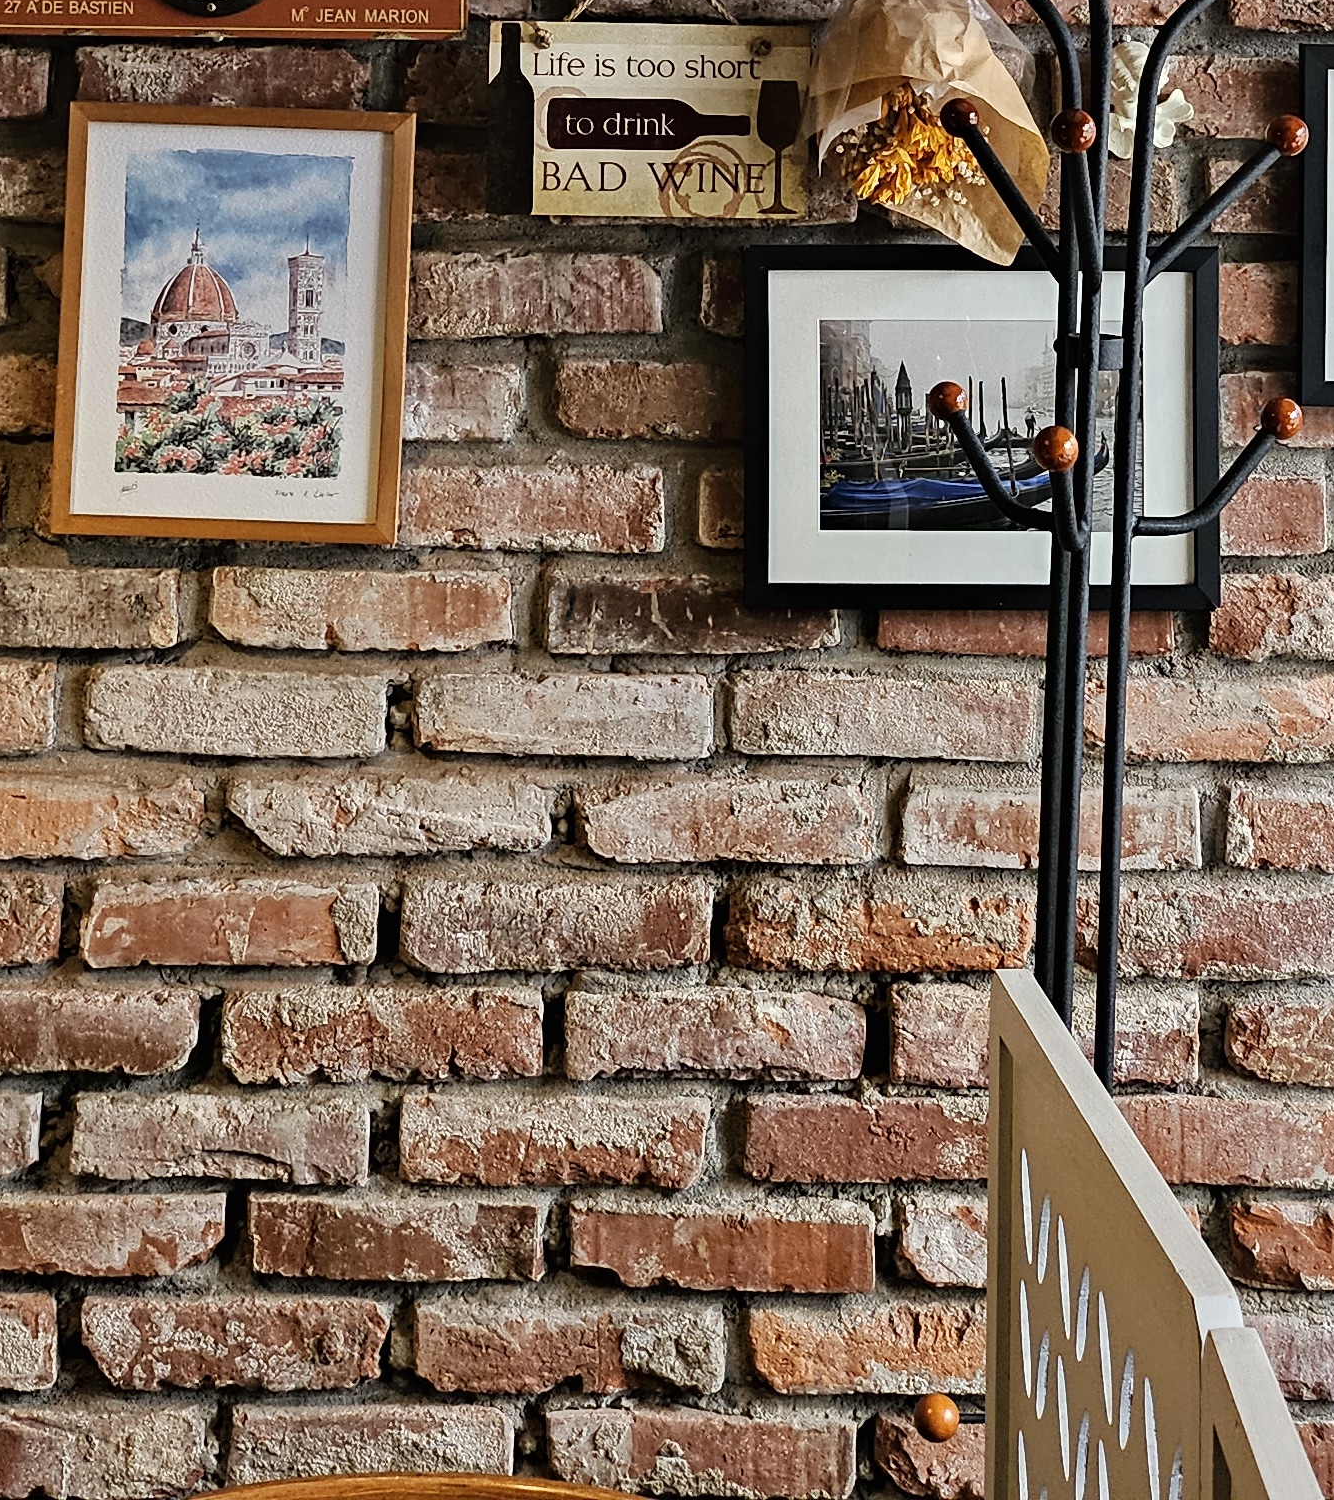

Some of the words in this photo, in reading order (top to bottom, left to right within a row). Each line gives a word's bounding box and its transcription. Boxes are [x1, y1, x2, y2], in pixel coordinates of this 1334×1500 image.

[4, 0, 21, 13] 27
[42, 0, 63, 14] DE
[69, 0, 134, 15] BASTIEN
[316, 8, 356, 23] JEAN
[364, 9, 429, 24] MARION
[532, 51, 585, 77] Life
[594, 53, 616, 78] is
[626, 55, 676, 79] too
[684, 54, 762, 80] short
[566, 113, 594, 136] to
[603, 113, 675, 137] drink
[541, 160, 627, 192] BAD
[647, 162, 766, 194] WINE
